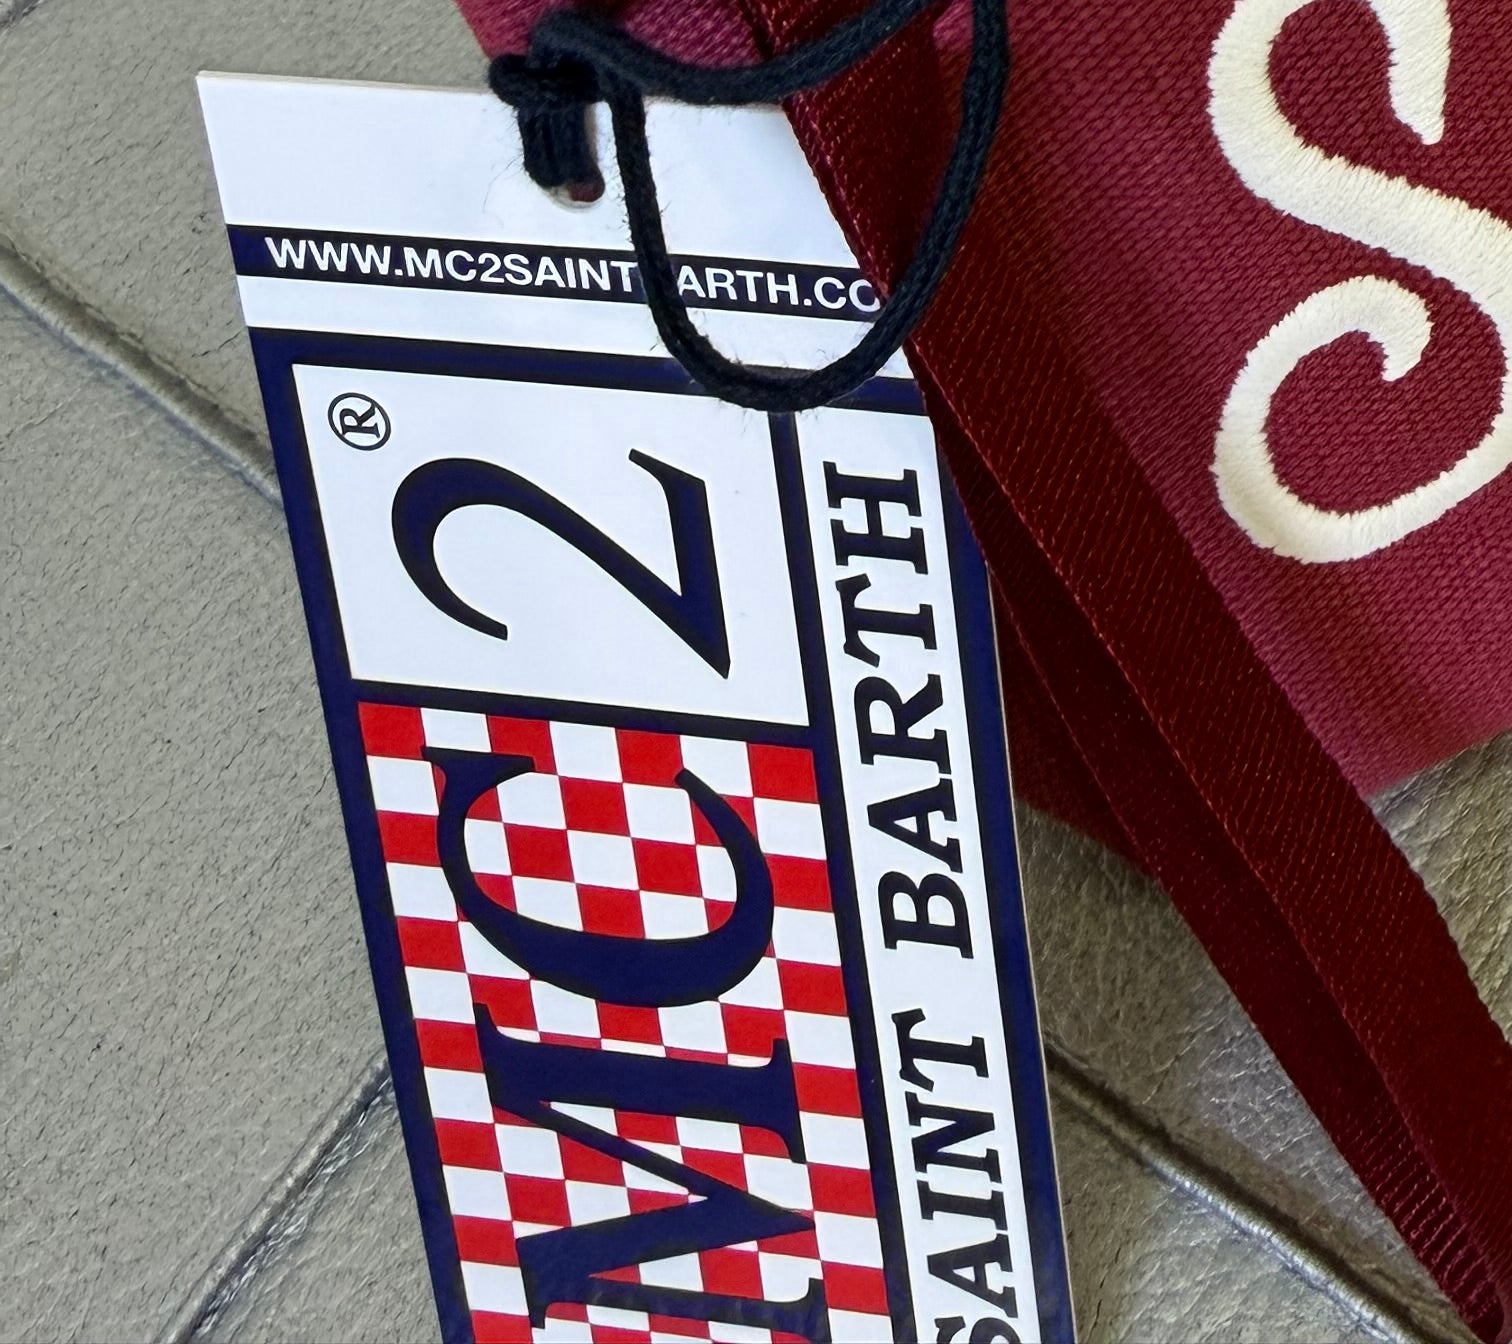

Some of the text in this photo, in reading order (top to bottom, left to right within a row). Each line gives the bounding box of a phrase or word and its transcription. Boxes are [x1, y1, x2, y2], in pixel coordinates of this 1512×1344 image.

[264, 237, 882, 313] WWW.MC2SAINTARTH.CO
[390, 447, 831, 1344] MC2
[822, 463, 973, 959] BARTH
